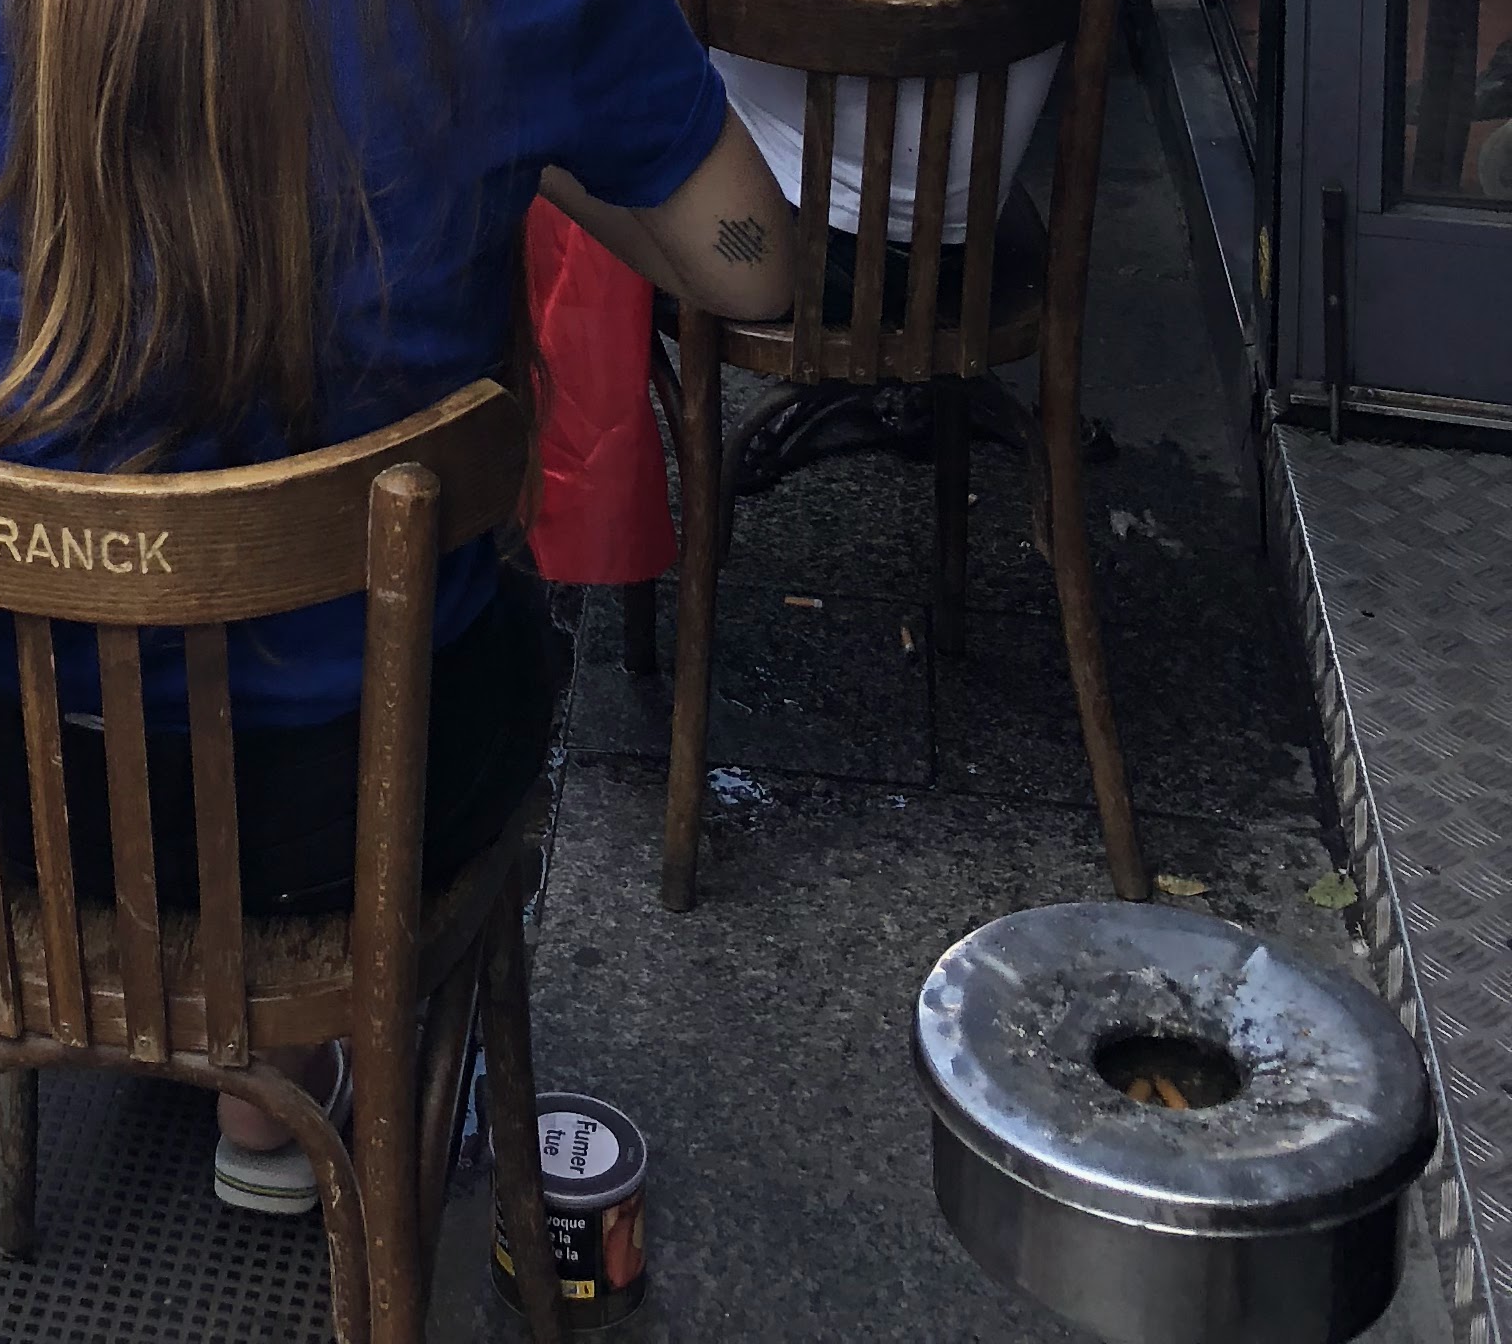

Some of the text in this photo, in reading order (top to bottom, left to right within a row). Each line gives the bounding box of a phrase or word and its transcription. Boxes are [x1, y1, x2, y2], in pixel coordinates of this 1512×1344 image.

[543, 1128, 566, 1156] tue
[570, 1119, 598, 1175] Fumer
[559, 1230, 571, 1244] la
[566, 1247, 579, 1261] la
